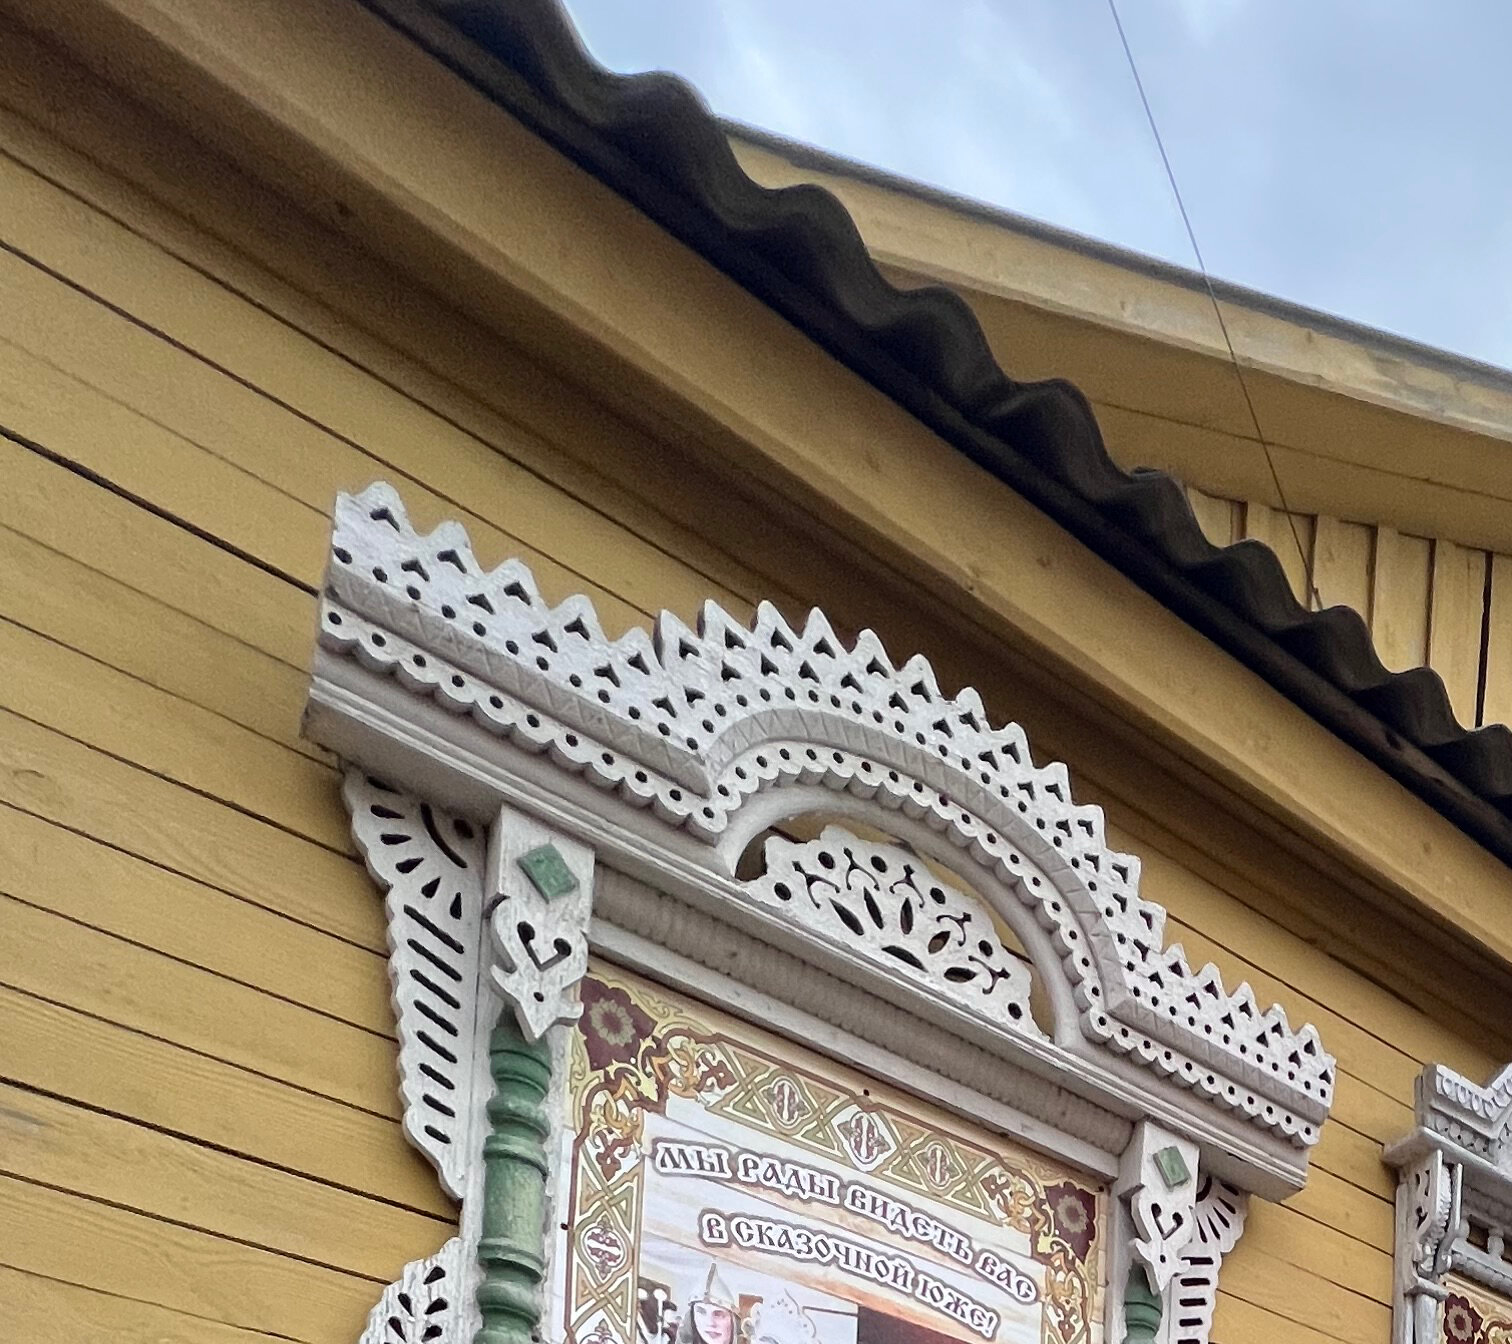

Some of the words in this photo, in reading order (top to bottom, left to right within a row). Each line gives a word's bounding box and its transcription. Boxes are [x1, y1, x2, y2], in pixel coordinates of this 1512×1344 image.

[655, 1143, 731, 1176] МЫ
[738, 1155, 840, 1203] РАДЫ
[847, 1185, 973, 1263] ВИДЕТЬ
[978, 1251, 1038, 1302] ВАС
[704, 1216, 729, 1242] В
[733, 1217, 915, 1289] СКАЗОЧНОЙ
[917, 1275, 999, 1337] ЮЖЕ!
